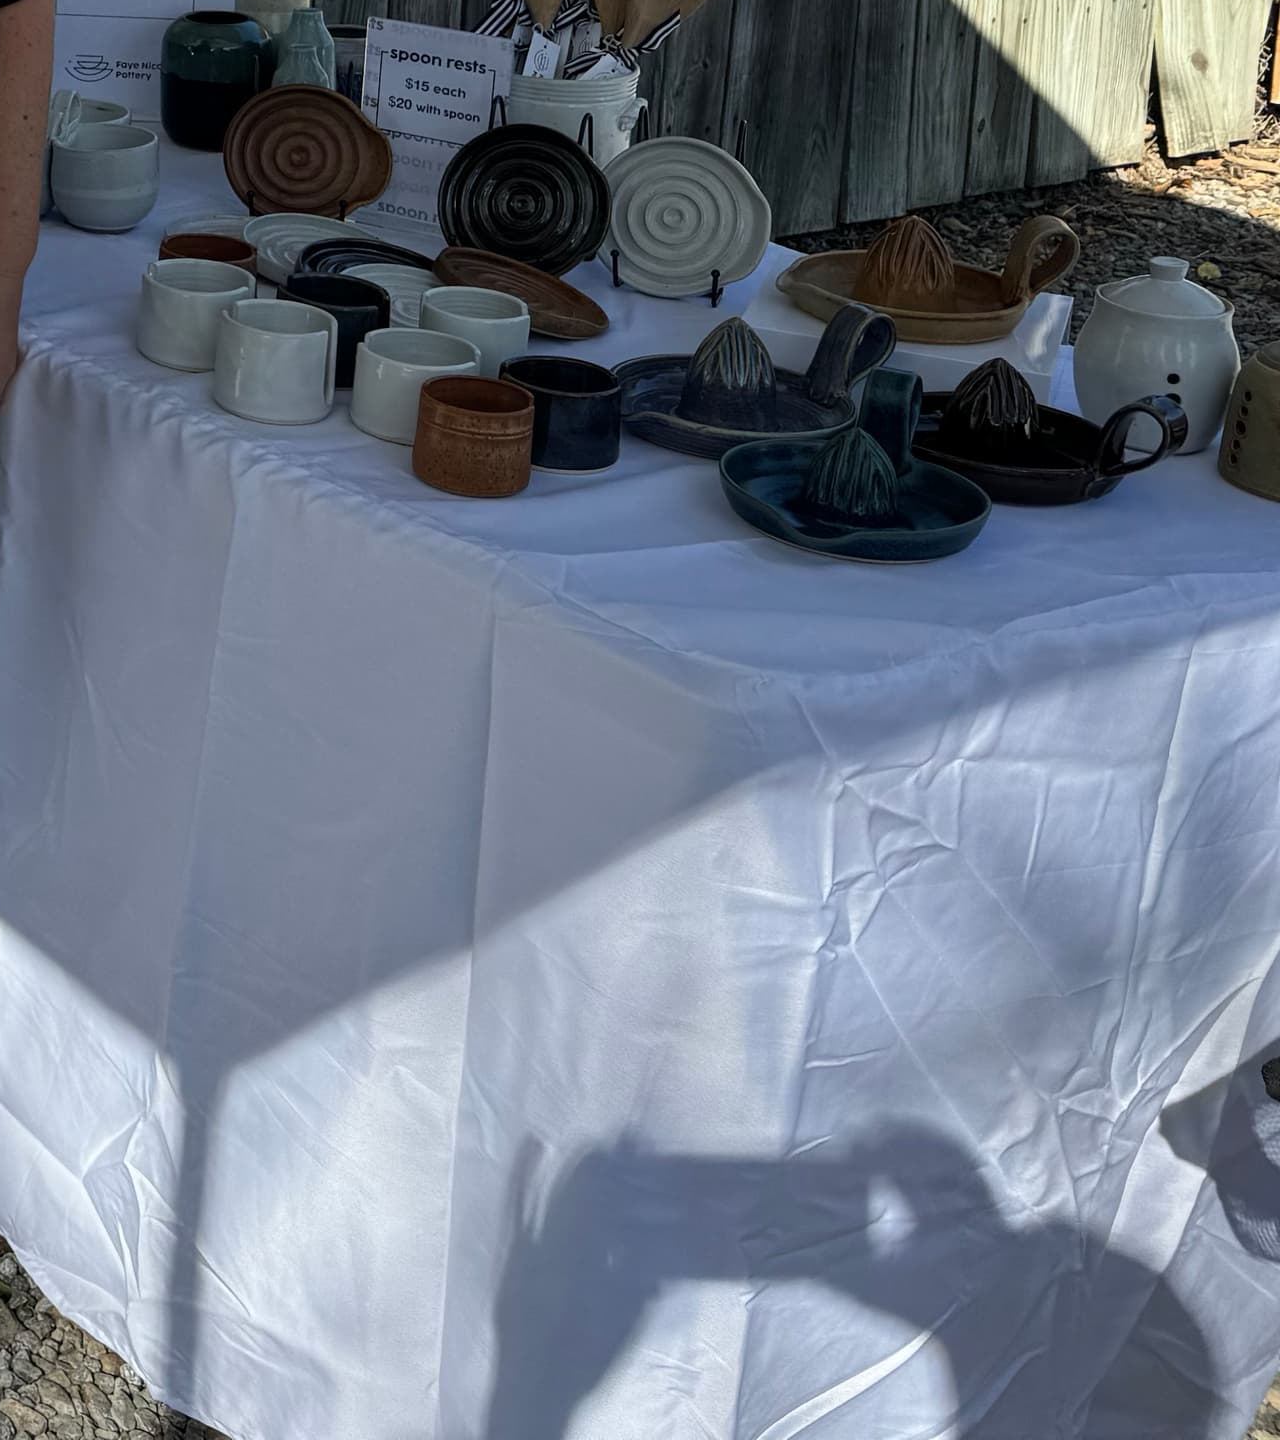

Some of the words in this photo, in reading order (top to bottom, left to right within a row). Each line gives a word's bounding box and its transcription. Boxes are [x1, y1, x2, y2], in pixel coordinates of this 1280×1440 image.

[115, 60, 140, 70] Faye
[390, 48, 442, 67] spoon
[446, 58, 487, 75] rests
[115, 71, 152, 81] Pottery
[405, 78, 430, 93] $15
[433, 86, 467, 99] each
[388, 96, 413, 111] $20
[416, 103, 441, 117] with
[443, 110, 481, 123] spoon
